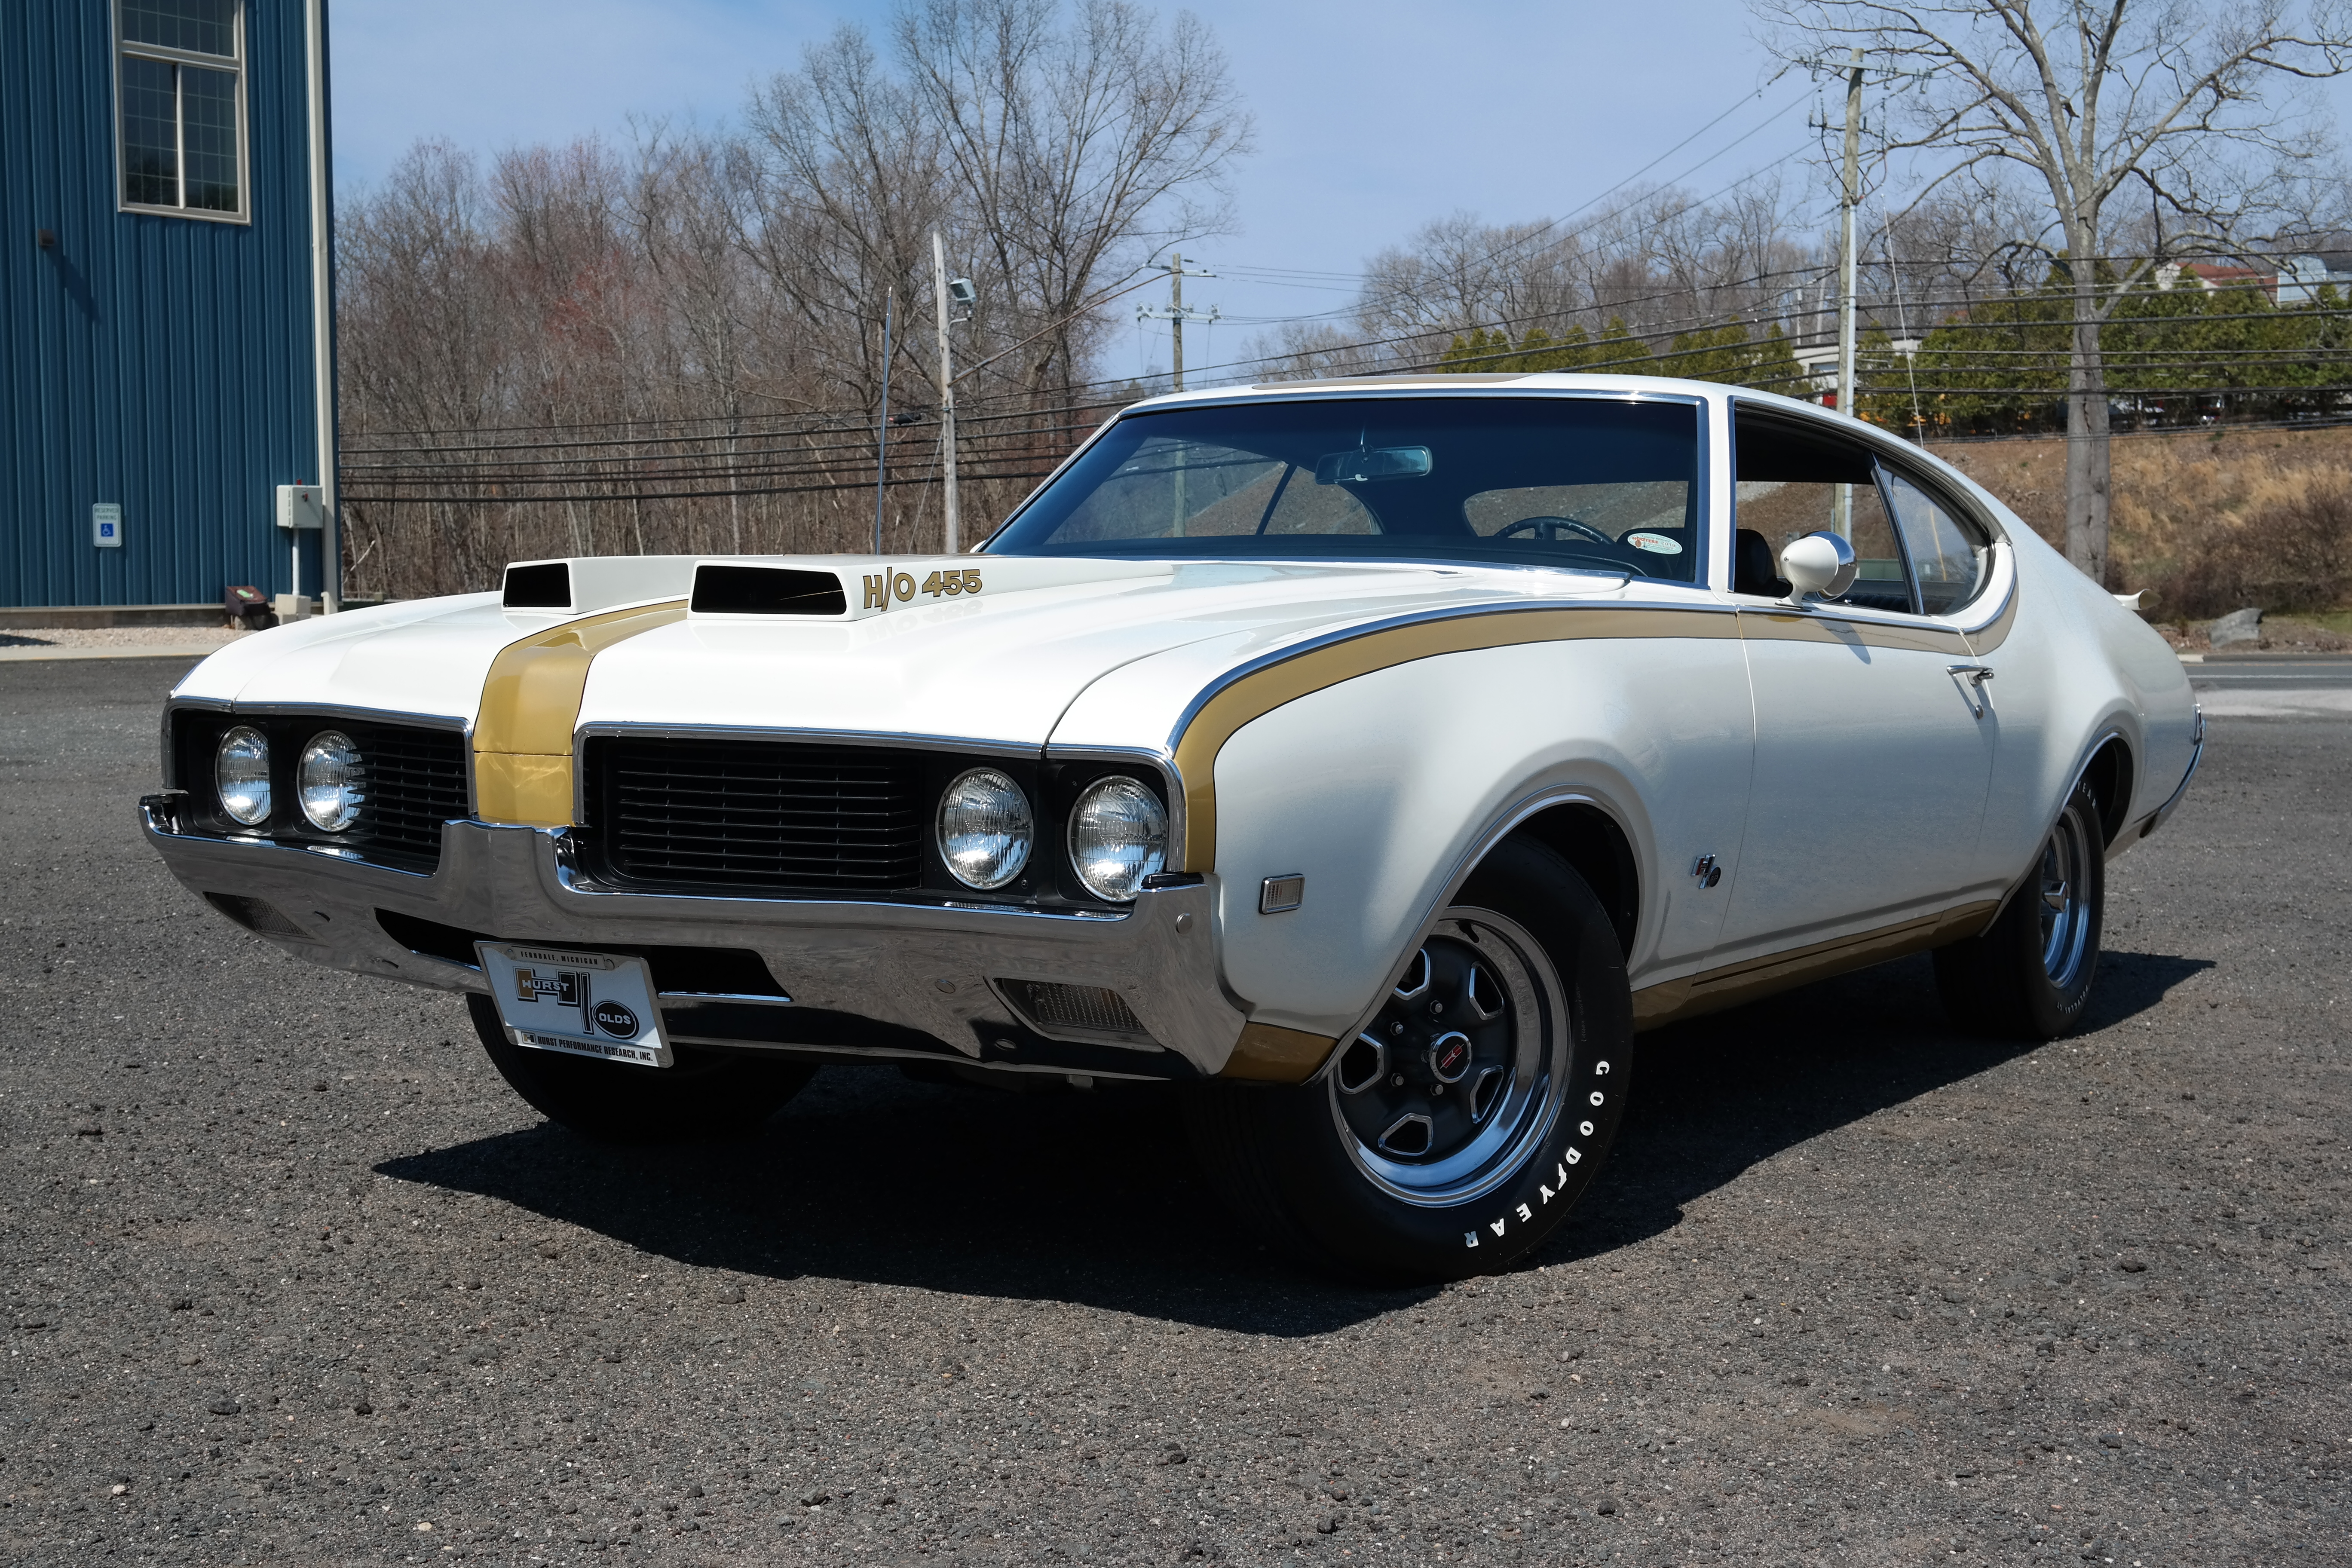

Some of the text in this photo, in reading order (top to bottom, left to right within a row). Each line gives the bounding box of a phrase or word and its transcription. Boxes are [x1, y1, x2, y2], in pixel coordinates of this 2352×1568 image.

[922, 569, 983, 597] 455
[521, 951, 598, 965] FERNDALE, MICHIGAN
[522, 980, 569, 991] HURST
[599, 1013, 631, 1025] OLDS
[537, 1036, 557, 1047] HURST
[559, 1039, 602, 1054] PERFORMANCE
[604, 1046, 638, 1060] RESEARCH,
[640, 1051, 653, 1061] INC.
